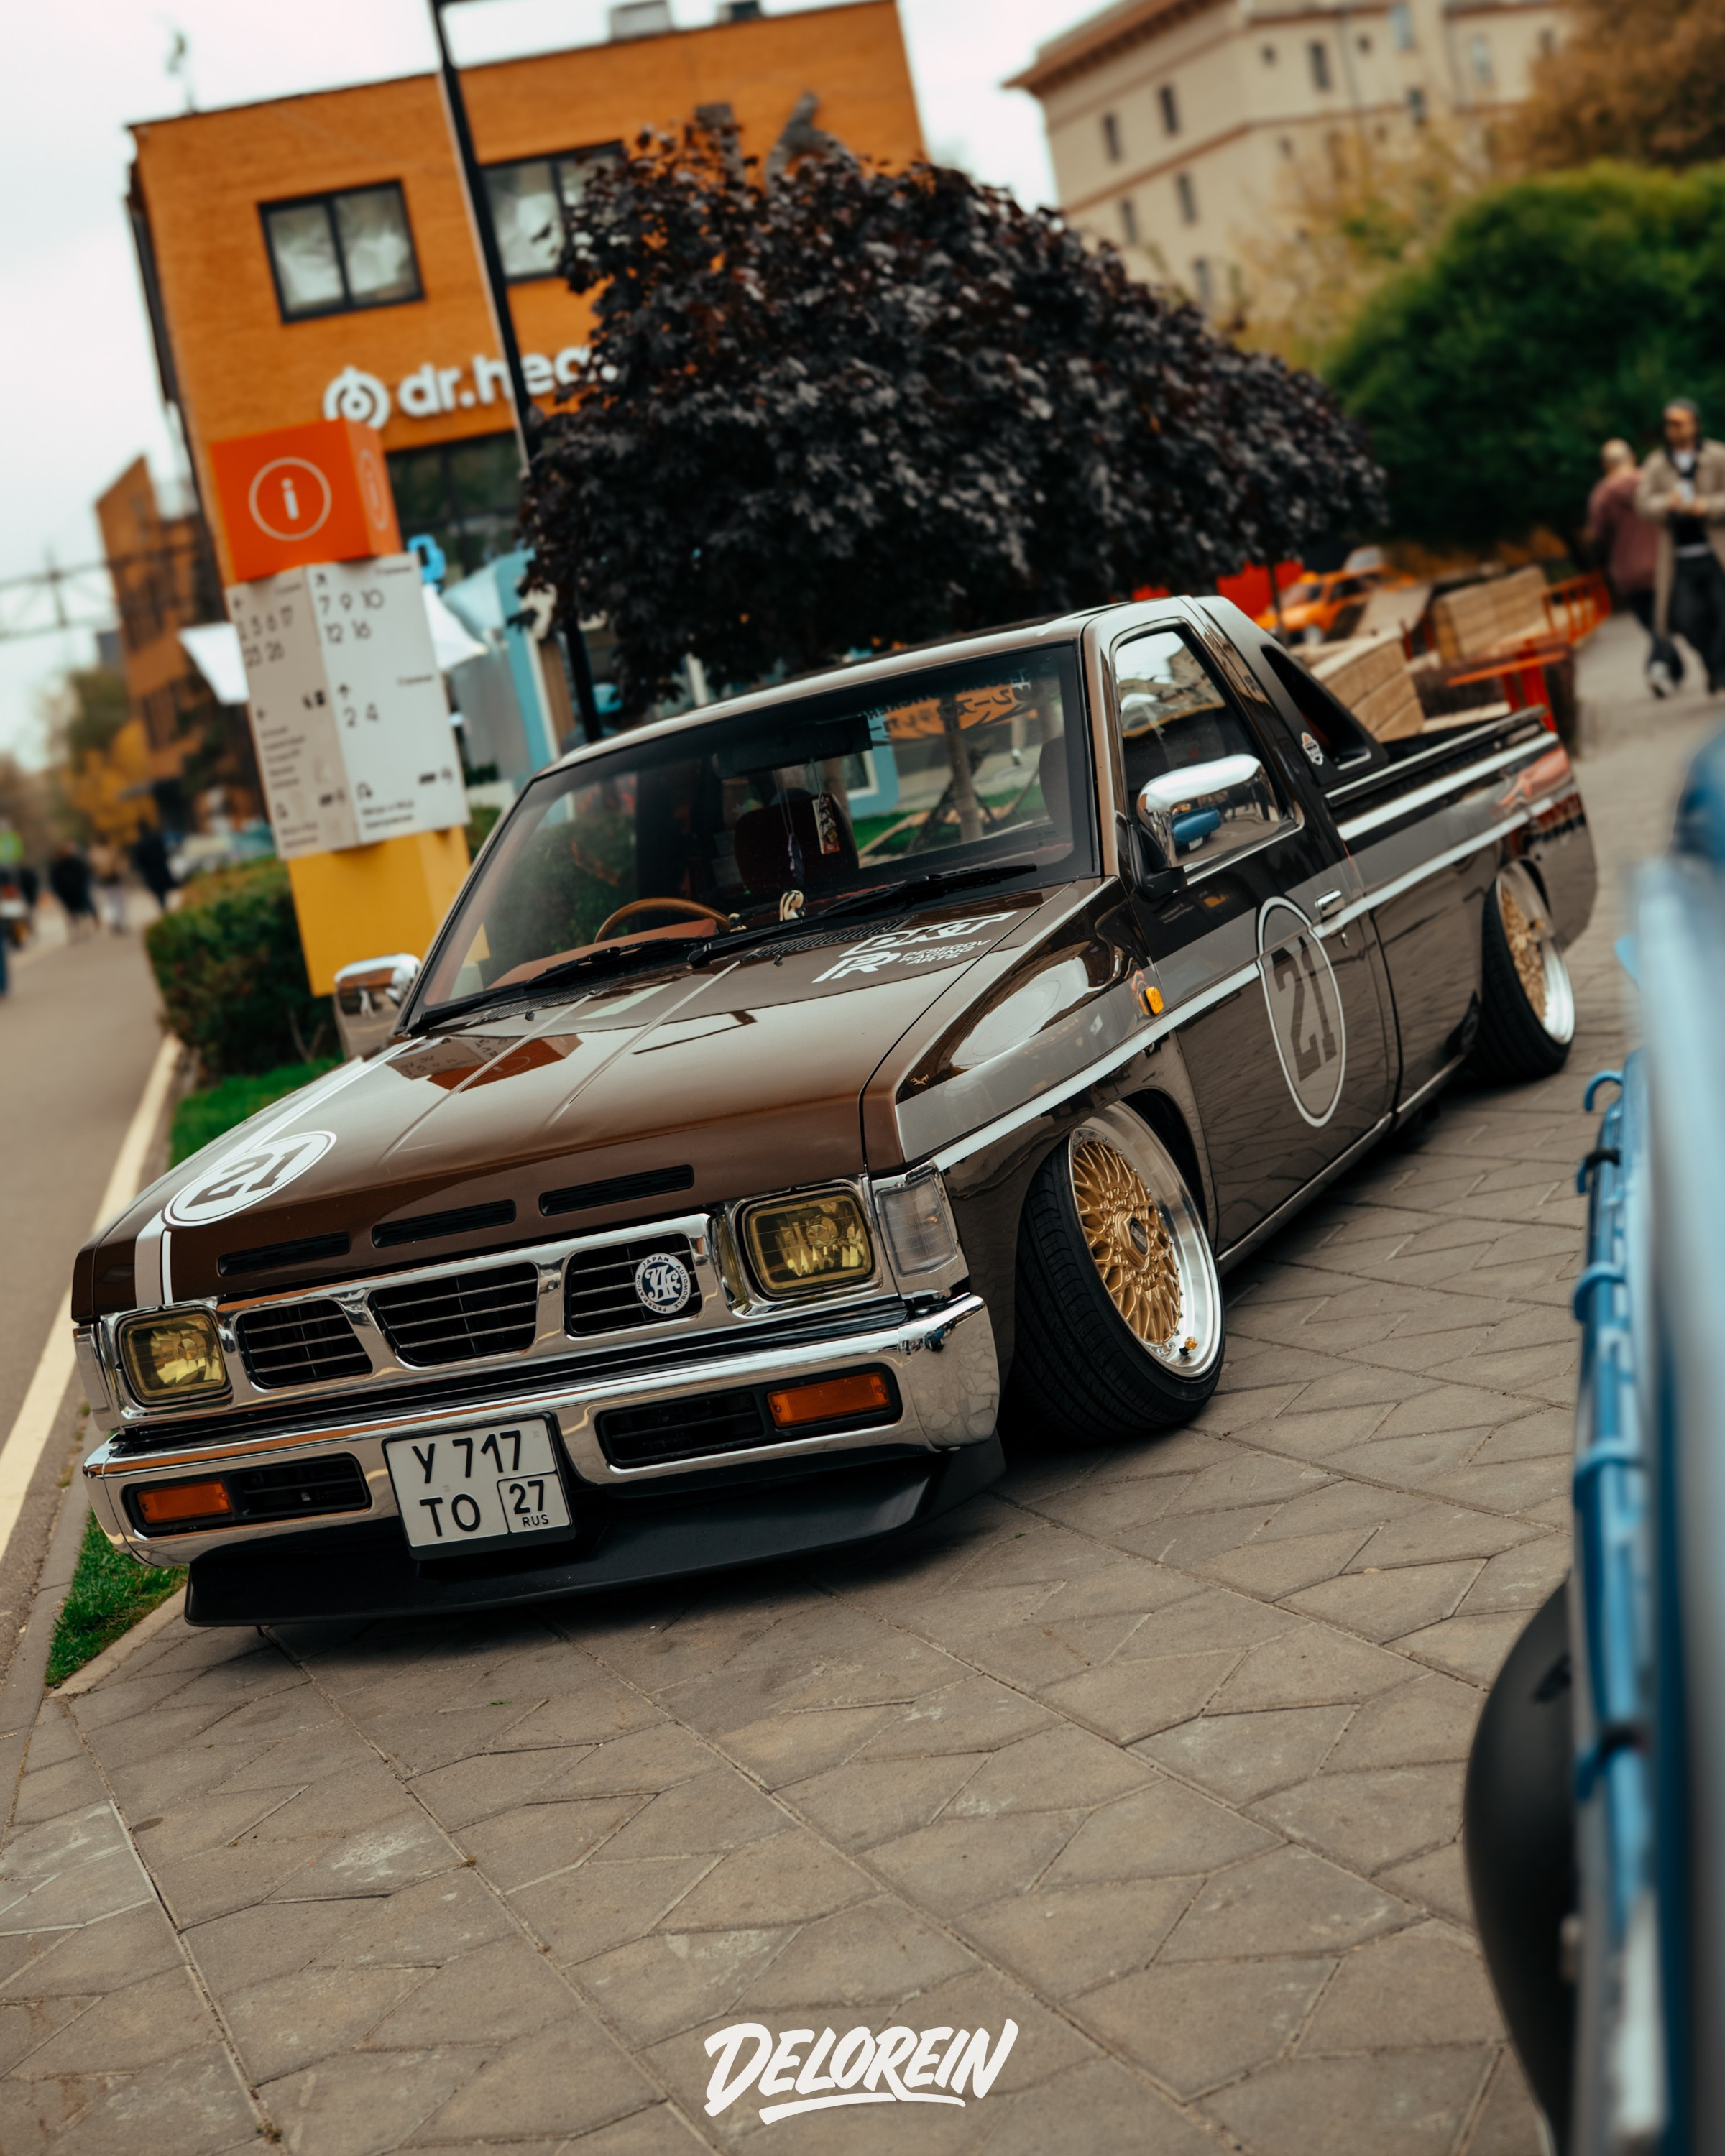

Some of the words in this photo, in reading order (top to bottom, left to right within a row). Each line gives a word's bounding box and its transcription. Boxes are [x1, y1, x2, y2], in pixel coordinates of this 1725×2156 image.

[397, 345, 620, 417] dr.hea
[361, 588, 385, 610] 10
[897, 946, 975, 963] RACING
[1271, 936, 1338, 1083] 21
[185, 1142, 313, 1209] 21
[643, 1256, 669, 1268] JAPAN
[636, 1274, 667, 1312] FEDERATION
[674, 1265, 689, 1309] AUTOMOBILE
[452, 1429, 521, 1478] 717
[509, 1479, 544, 1514] 27
[522, 1514, 549, 1527] RUS
